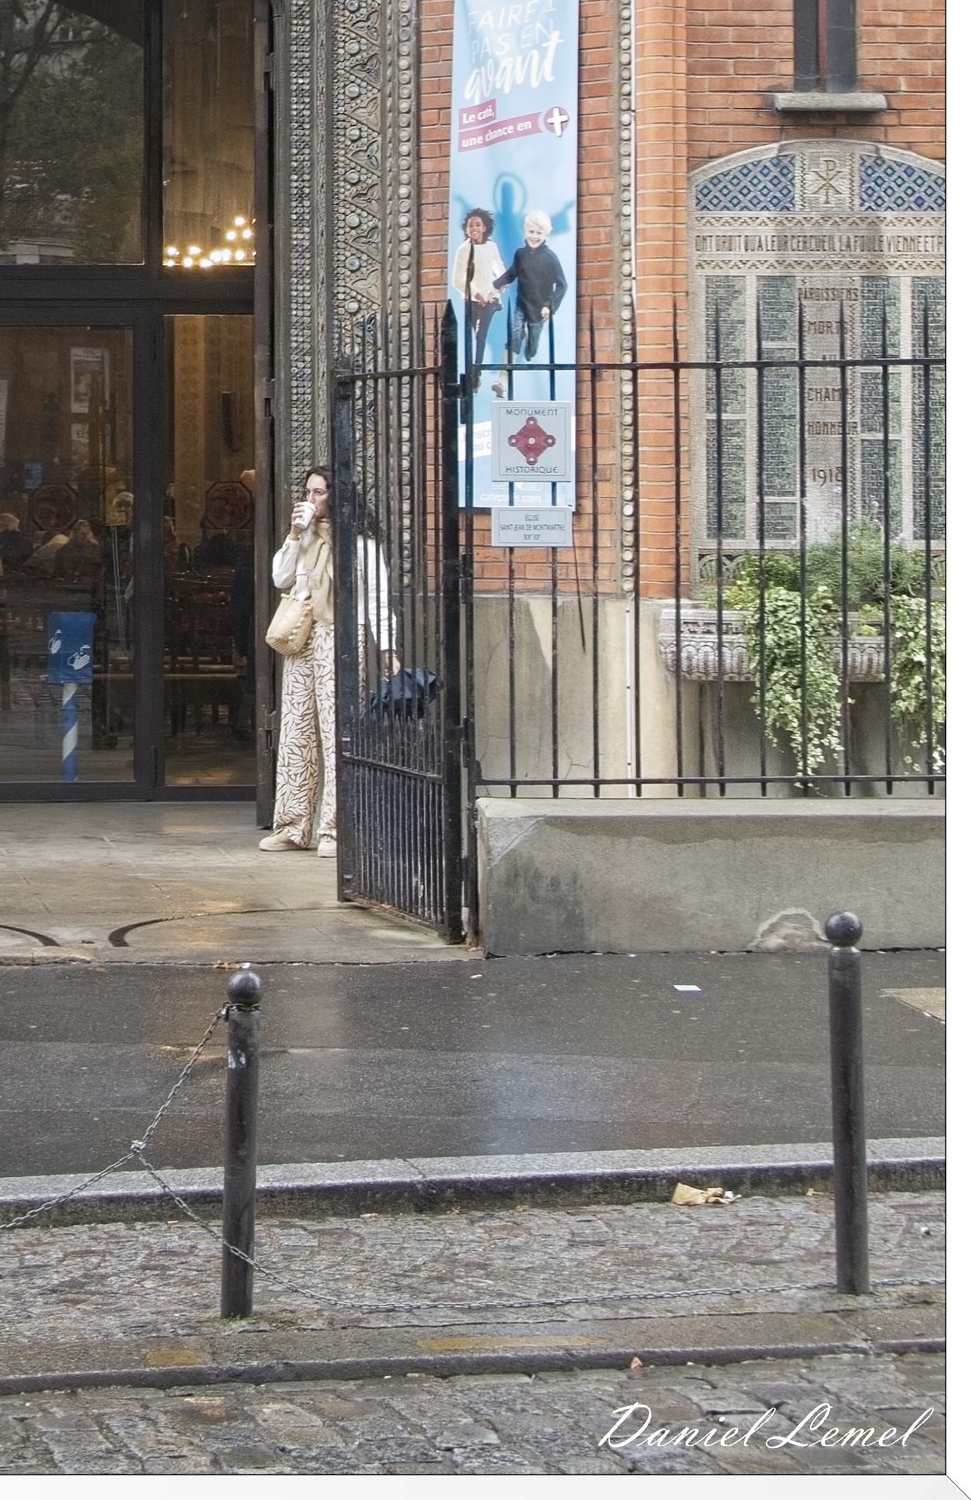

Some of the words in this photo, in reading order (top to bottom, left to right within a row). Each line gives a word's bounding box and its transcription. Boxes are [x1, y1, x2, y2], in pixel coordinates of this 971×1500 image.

[468, 0, 540, 32] FAIRE
[471, 33, 511, 64] PAS
[520, 19, 553, 49] EN
[464, 30, 565, 105] avant
[462, 113, 476, 124] Le
[462, 135, 484, 147] une
[485, 124, 515, 141] chance
[517, 121, 532, 131] en
[505, 408, 559, 416] MONUMENT
[505, 466, 559, 474] HISTORIQUE
